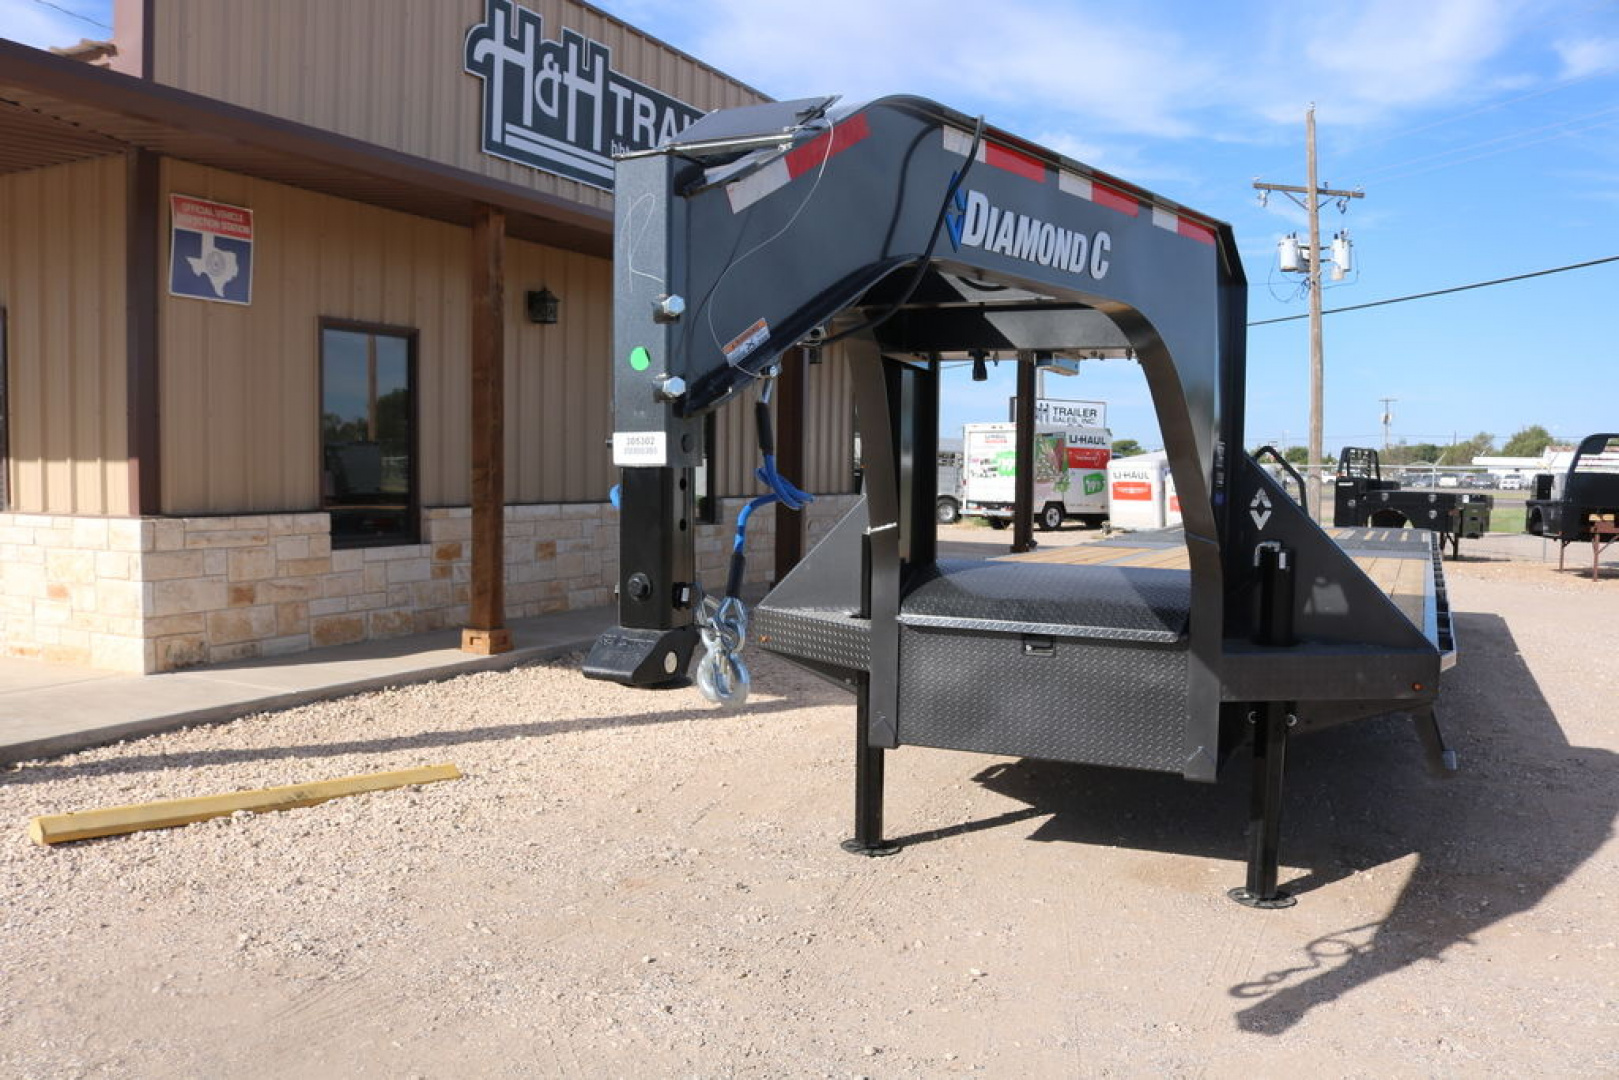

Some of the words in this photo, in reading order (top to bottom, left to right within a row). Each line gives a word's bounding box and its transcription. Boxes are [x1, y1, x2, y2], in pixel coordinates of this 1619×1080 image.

[608, 81, 700, 150] TRA
[1090, 231, 1111, 280] C
[1053, 406, 1098, 417] TRAILER
[1069, 434, 1106, 445] U-HAUL
